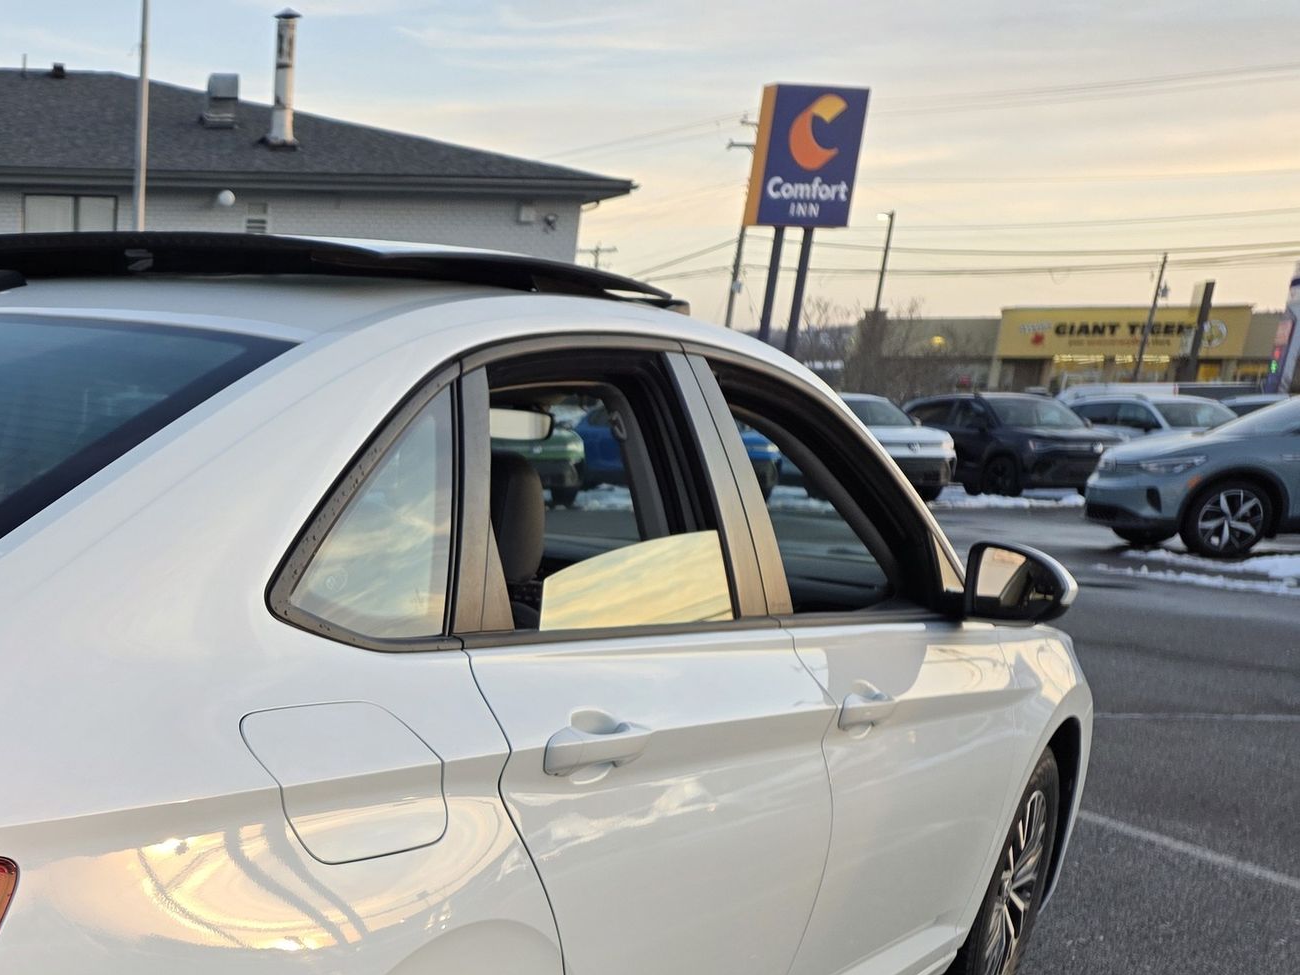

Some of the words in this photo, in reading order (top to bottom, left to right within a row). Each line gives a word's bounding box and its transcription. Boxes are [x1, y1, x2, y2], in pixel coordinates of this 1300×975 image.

[767, 176, 848, 200] Comfort
[789, 202, 820, 217] INN
[1054, 321, 1120, 337] GIANT
